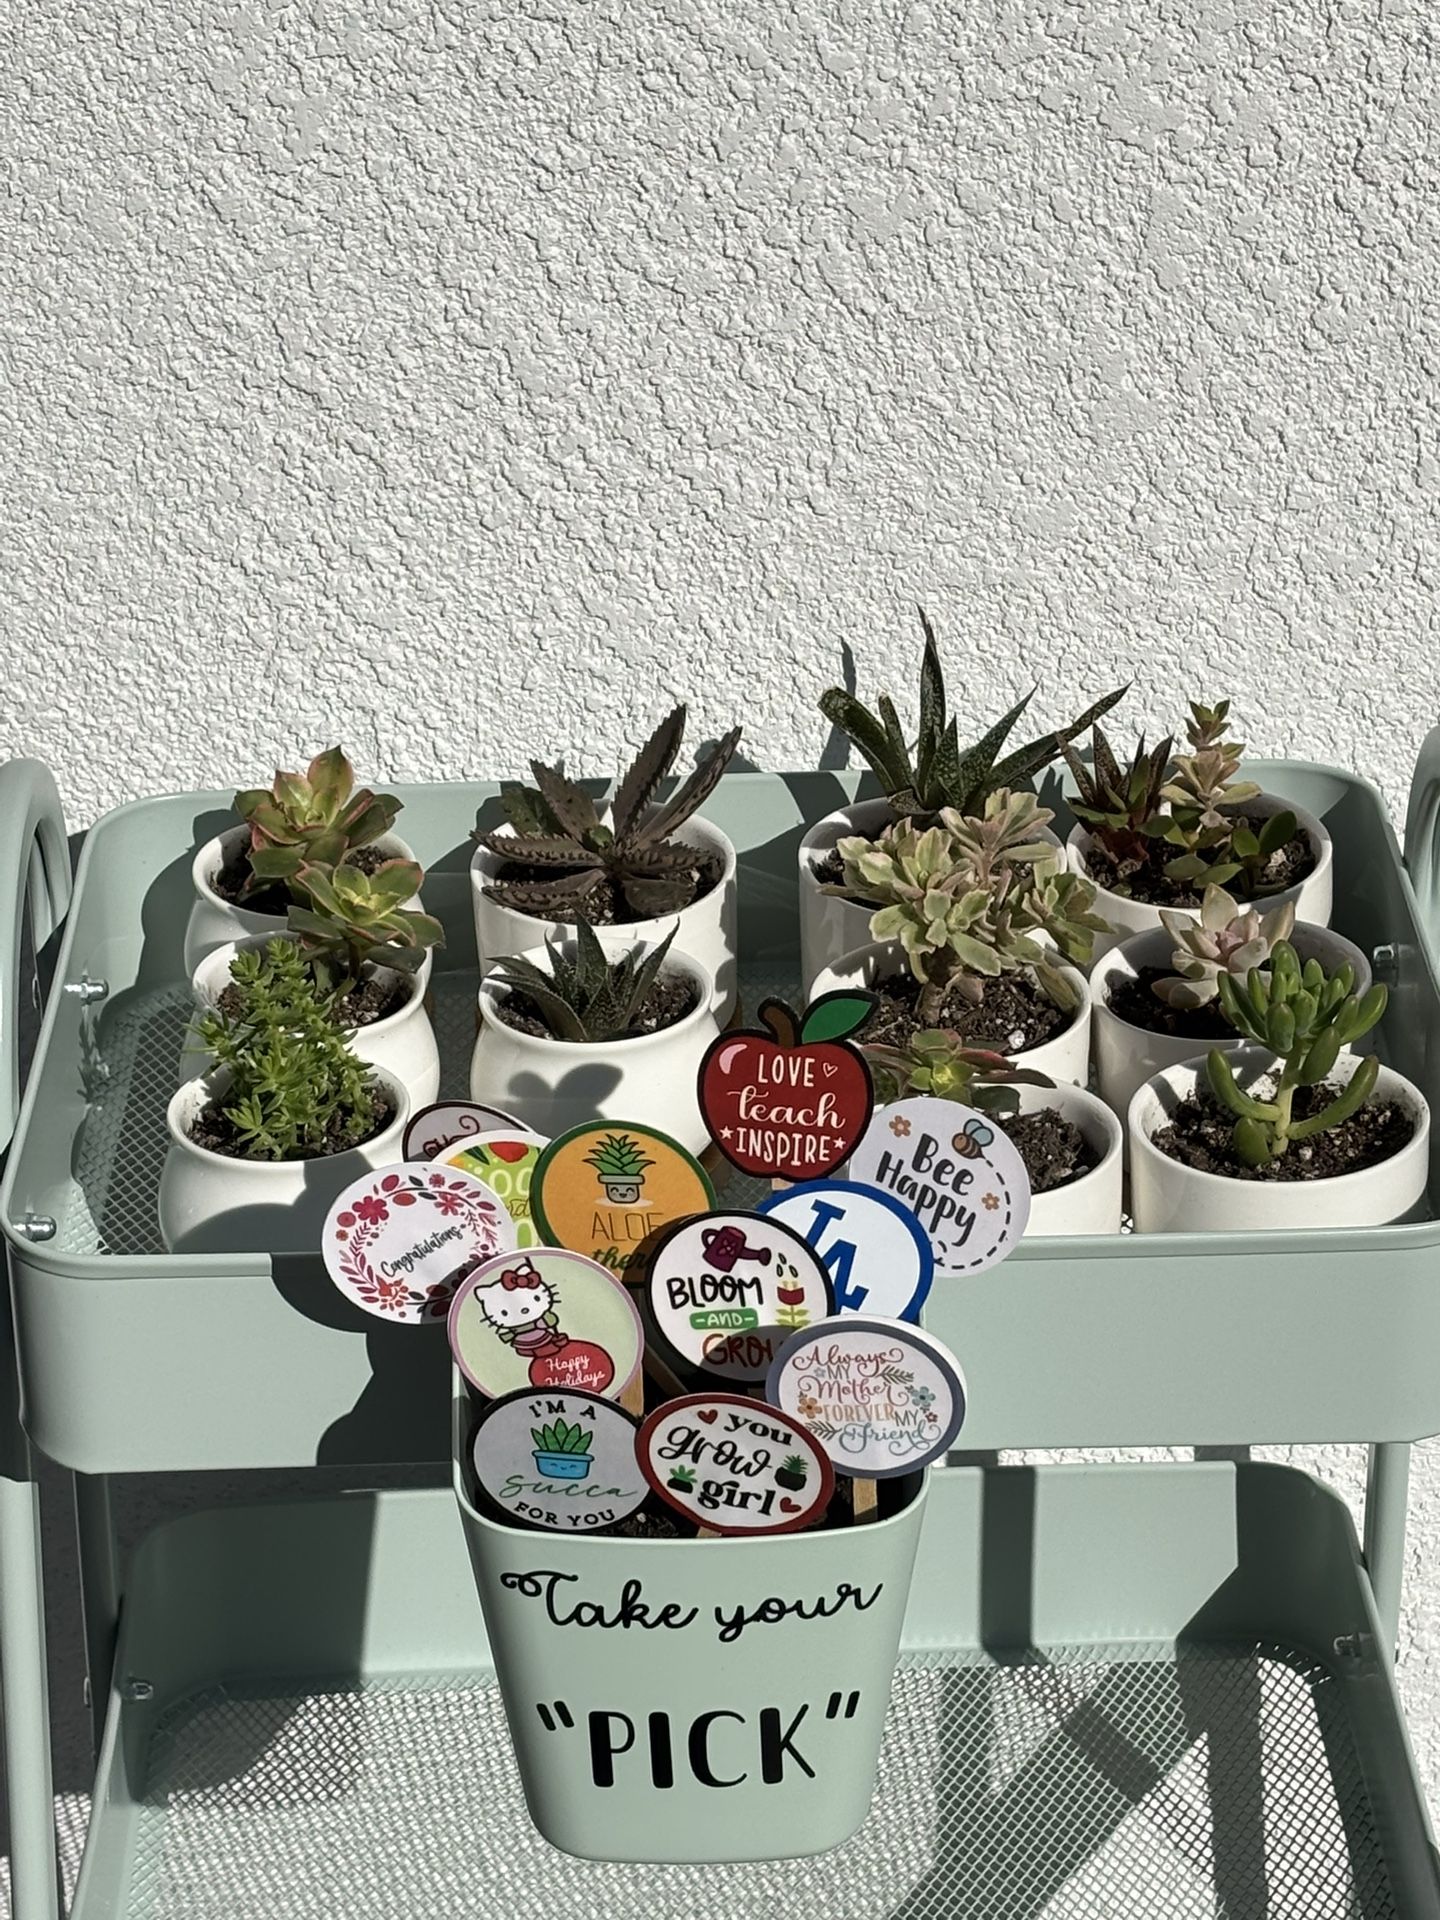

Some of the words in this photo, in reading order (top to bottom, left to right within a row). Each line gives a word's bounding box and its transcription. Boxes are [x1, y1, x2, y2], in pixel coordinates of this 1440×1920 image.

[758, 1054, 815, 1087] LOVE
[727, 1085, 846, 1129] teach
[736, 1127, 831, 1167] INSPIRE
[911, 1133, 974, 1196] Bee
[875, 1150, 977, 1247] Happy
[591, 1211, 664, 1241] ALOE
[380, 1226, 463, 1277] Congratulations
[591, 1246, 648, 1270] ther
[666, 1274, 764, 1310] BLOOM
[545, 1355, 590, 1372] Happy
[792, 1344, 904, 1377] Always
[827, 1364, 850, 1380] MY
[797, 1375, 909, 1406] Mother
[529, 1400, 567, 1418] I'M
[580, 1405, 597, 1420] A
[823, 1402, 894, 1421] FOREVER
[894, 1410, 919, 1427] MY
[724, 1412, 793, 1447] you
[839, 1420, 941, 1456] Friend
[658, 1426, 773, 1478] grow
[514, 1501, 559, 1525] FOR
[567, 1509, 616, 1527] YOU
[697, 1480, 777, 1517] girl
[500, 1570, 700, 1630] Take
[714, 1582, 884, 1643] your
[536, 1690, 861, 1789] "PICK"
